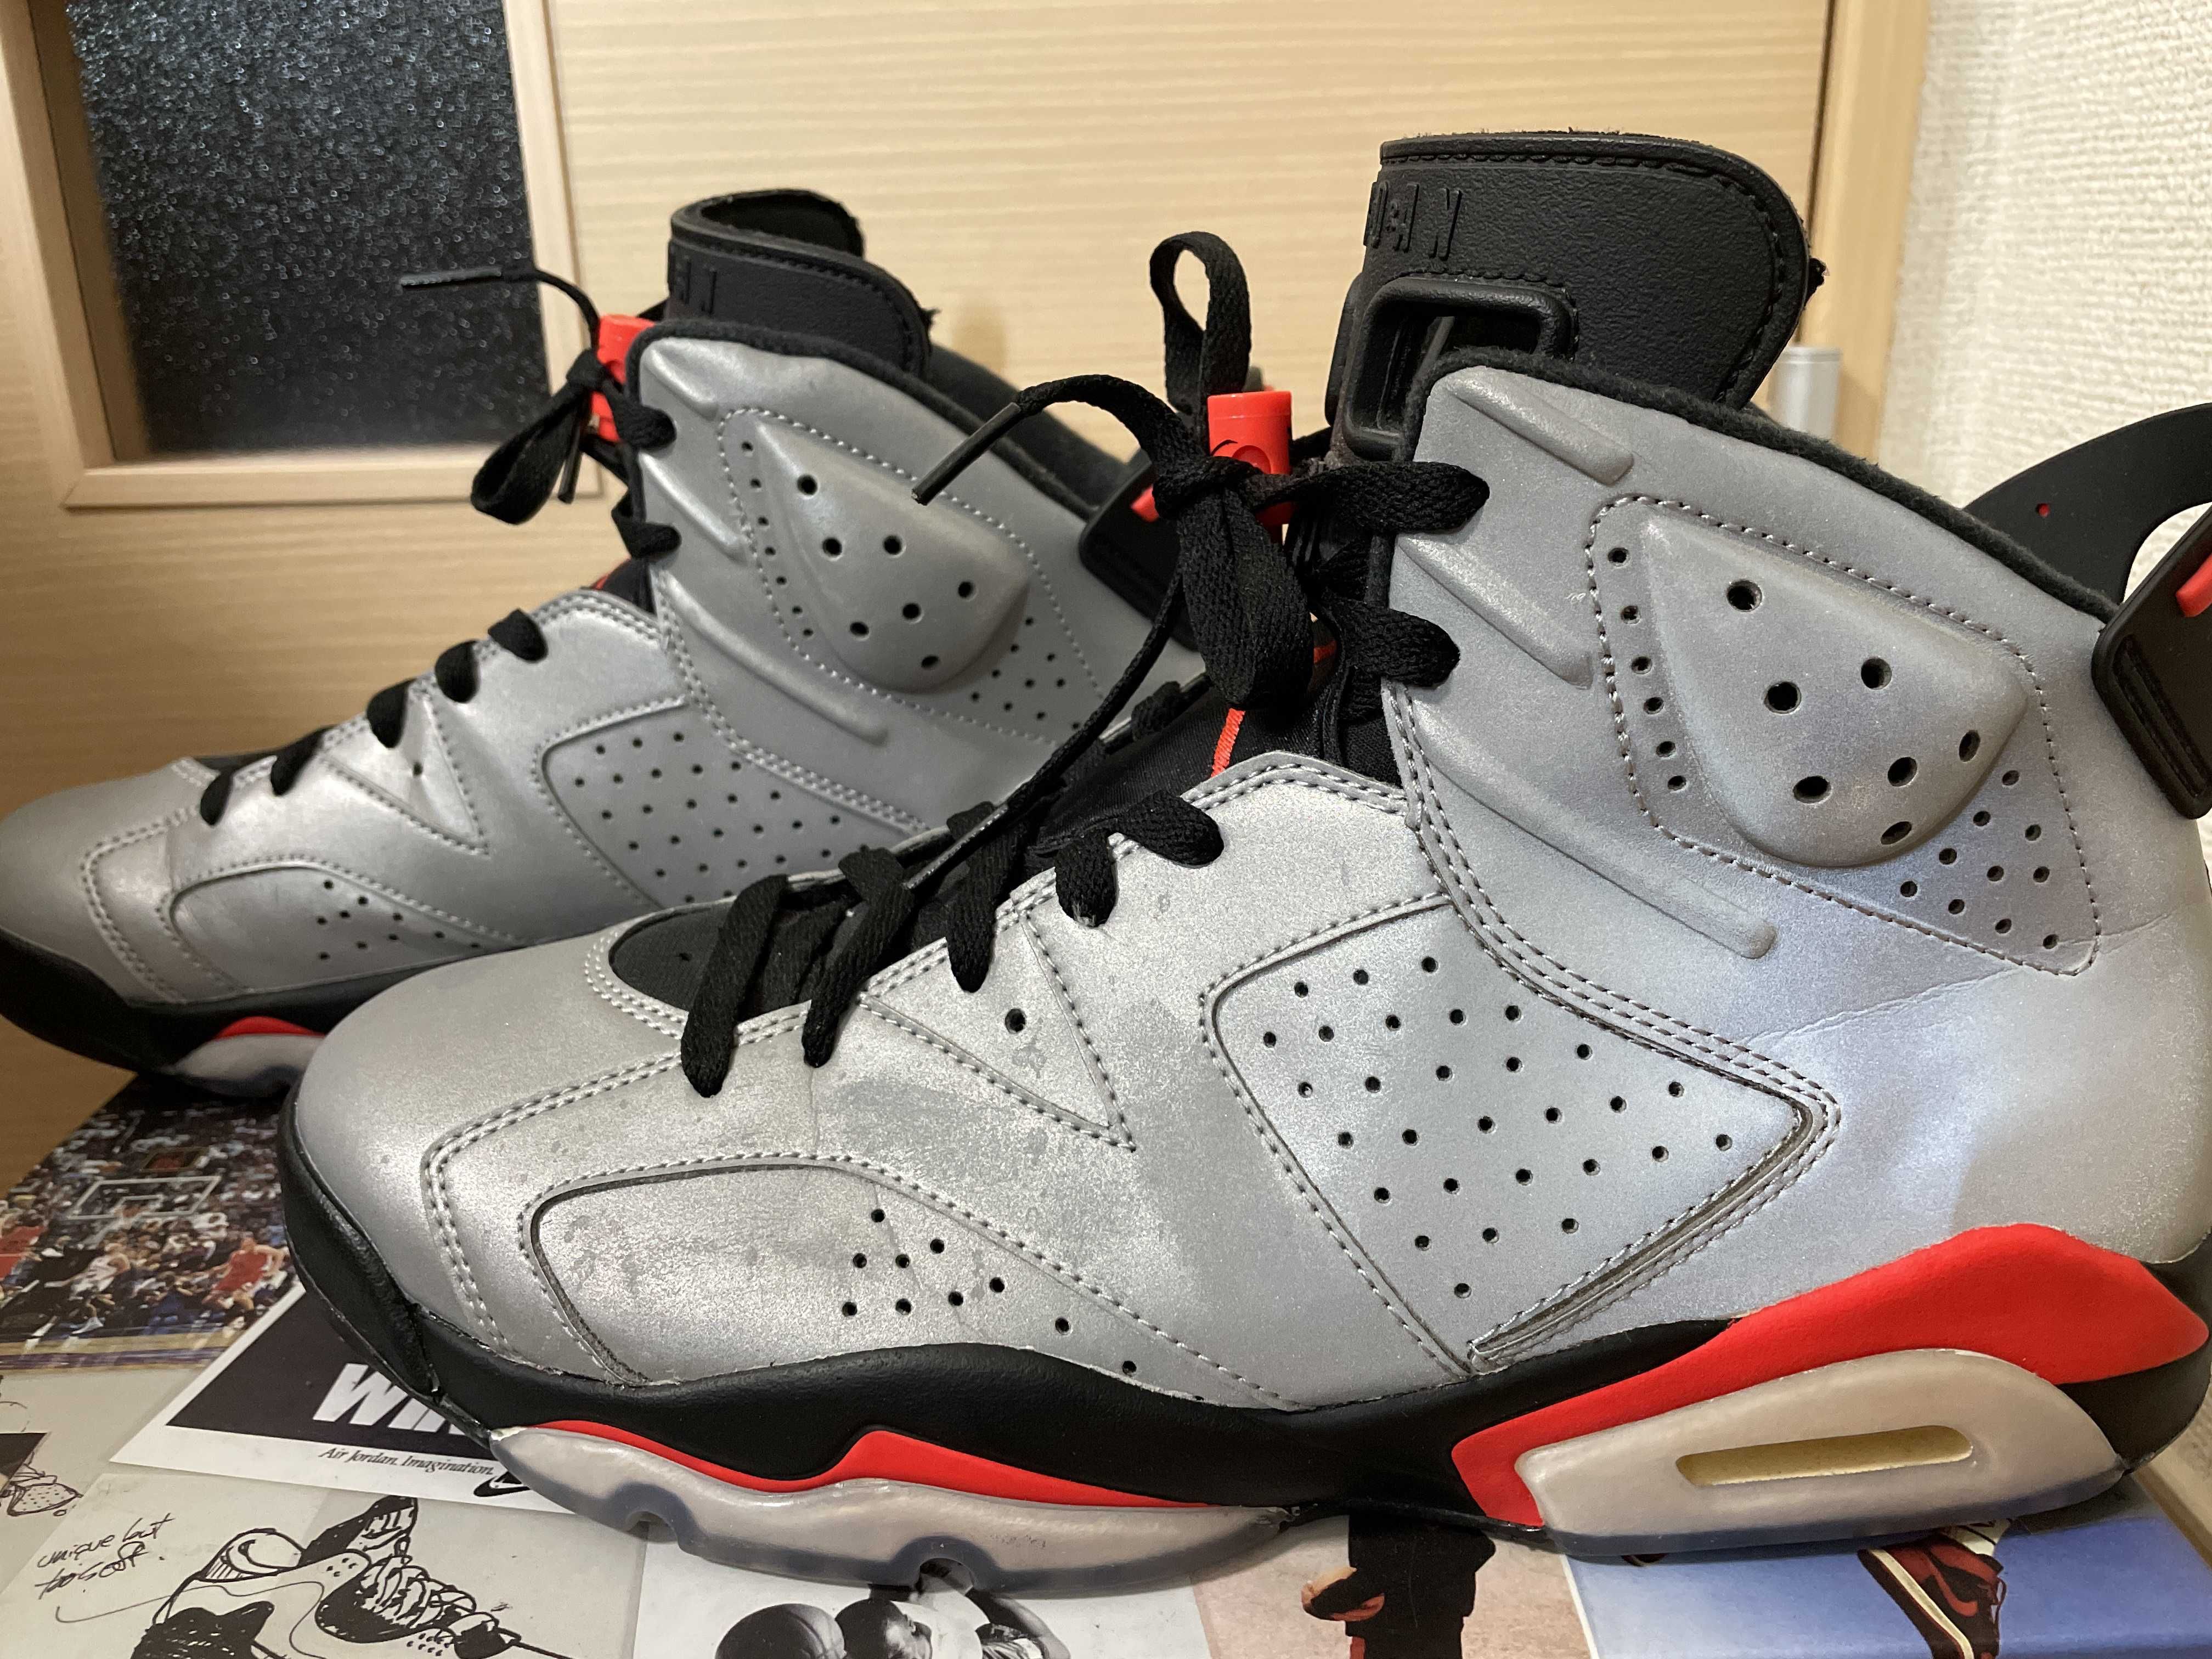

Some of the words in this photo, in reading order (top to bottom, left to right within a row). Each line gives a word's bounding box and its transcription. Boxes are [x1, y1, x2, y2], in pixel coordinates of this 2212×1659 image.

[318, 1447, 348, 1459] Air
[345, 1450, 397, 1465] Jordan.
[402, 1455, 494, 1475] Imagination.
[37, 1534, 115, 1568] unique
